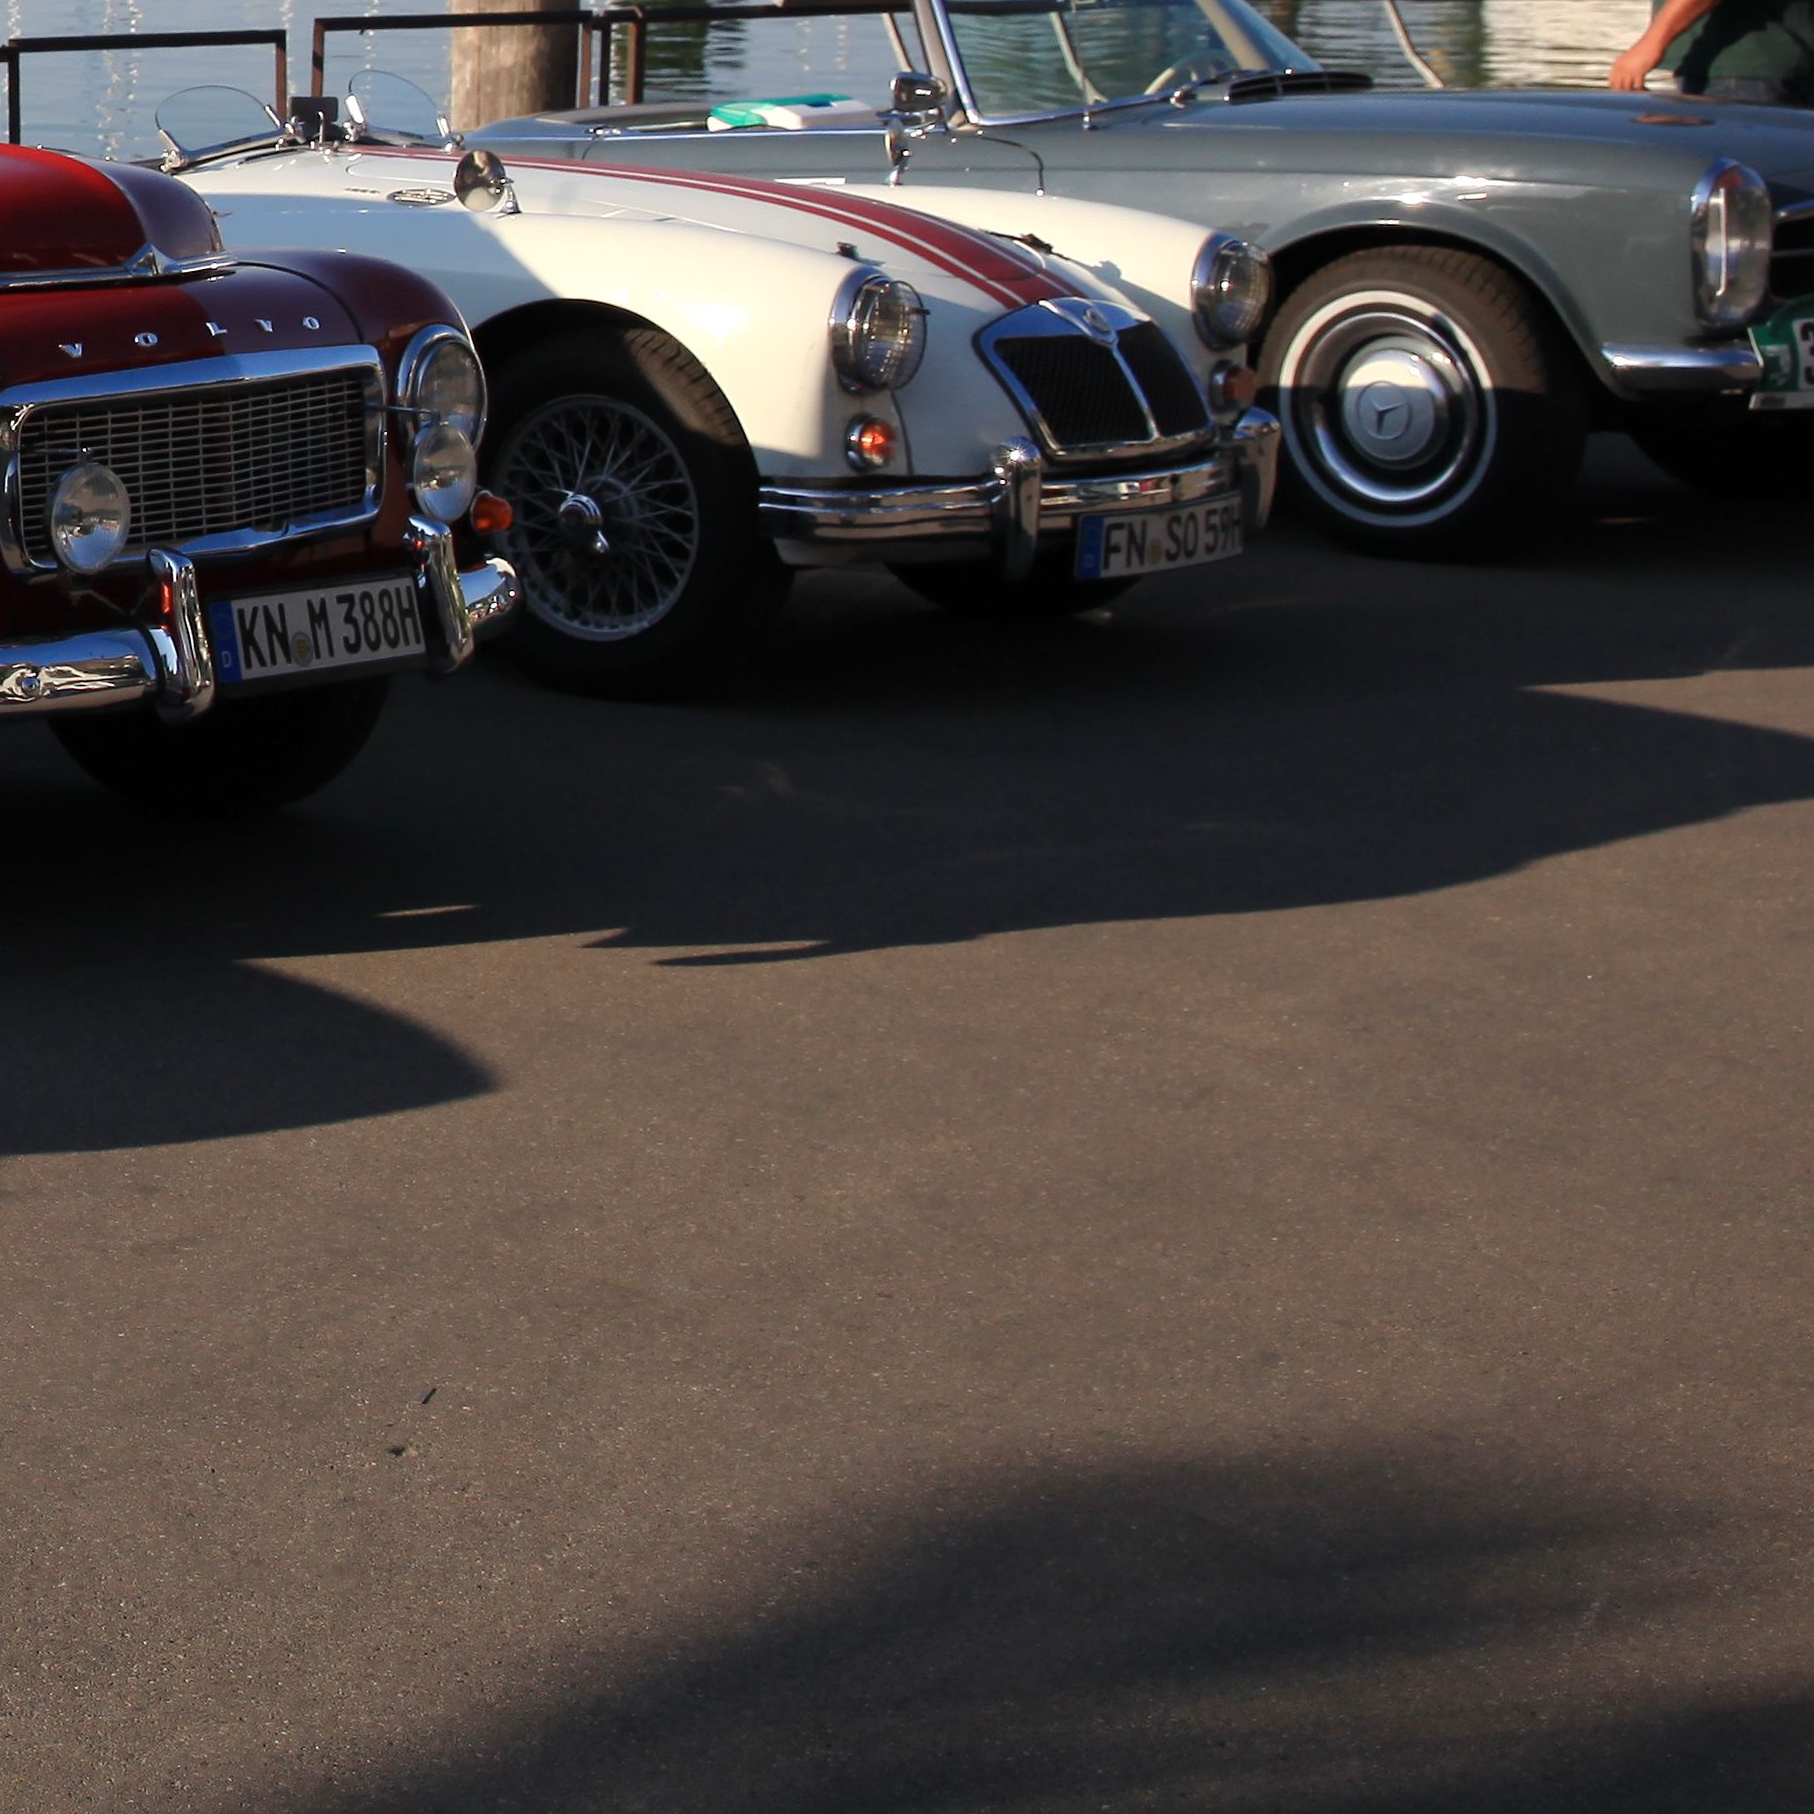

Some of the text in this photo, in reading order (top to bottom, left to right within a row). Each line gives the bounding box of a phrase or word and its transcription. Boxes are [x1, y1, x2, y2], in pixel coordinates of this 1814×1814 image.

[58, 315, 322, 359] VOLVO
[1102, 520, 1147, 570] FN
[236, 584, 422, 670] KN M 388H
